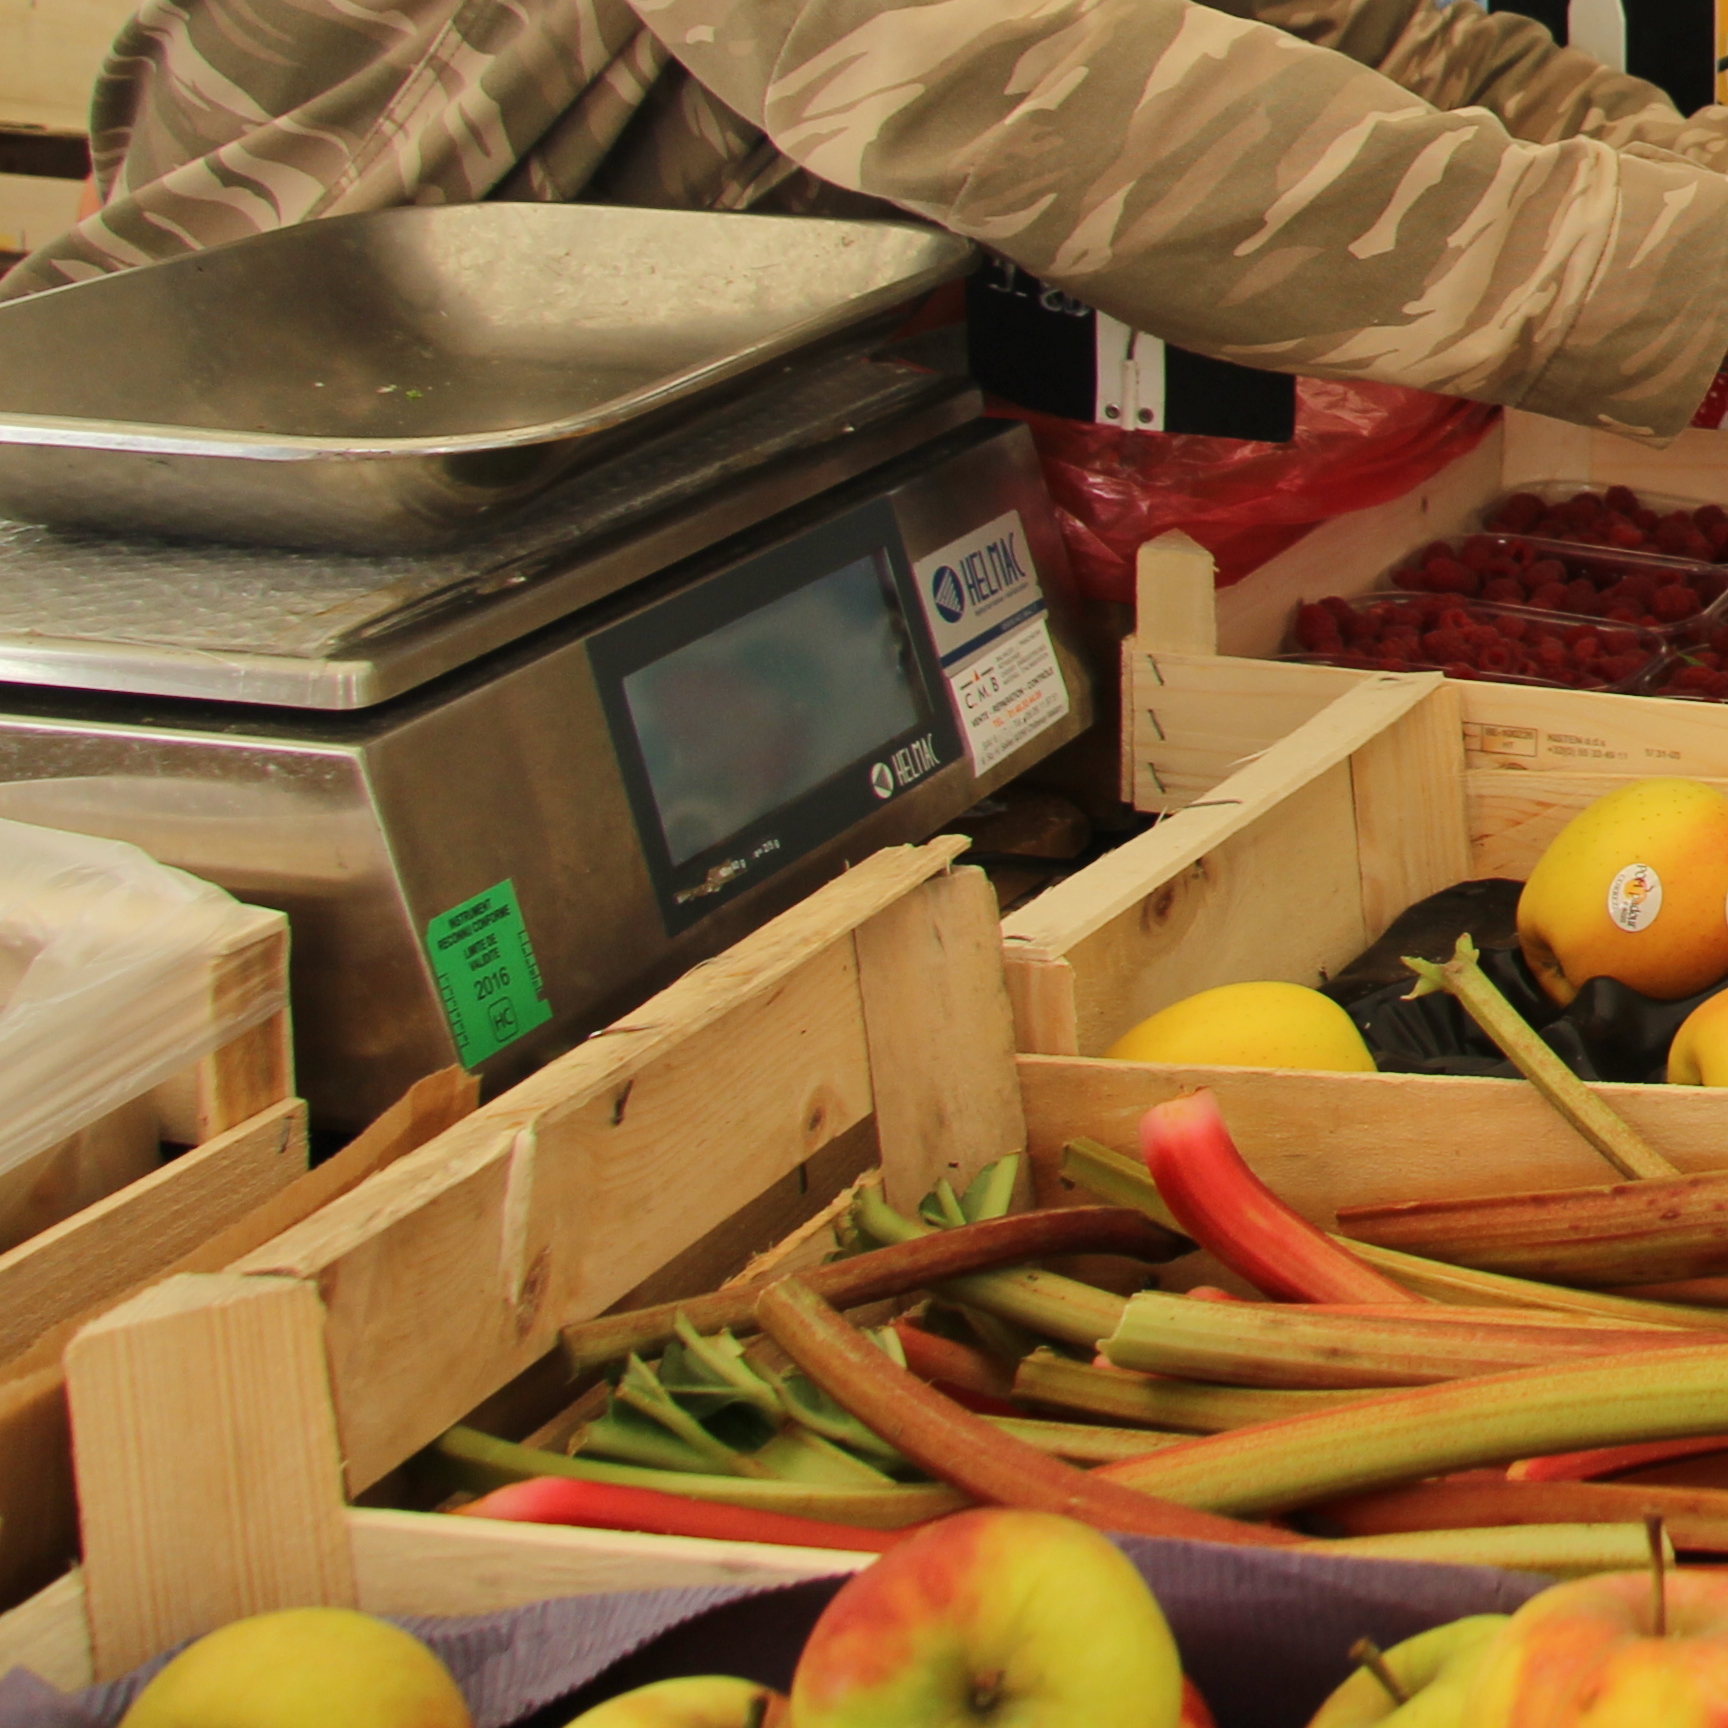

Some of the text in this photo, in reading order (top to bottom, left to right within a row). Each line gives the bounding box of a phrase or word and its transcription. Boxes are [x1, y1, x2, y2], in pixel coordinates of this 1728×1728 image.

[959, 531, 1027, 607] HELMAC
[891, 732, 941, 787] HELMAC
[474, 966, 511, 1001] 2016
